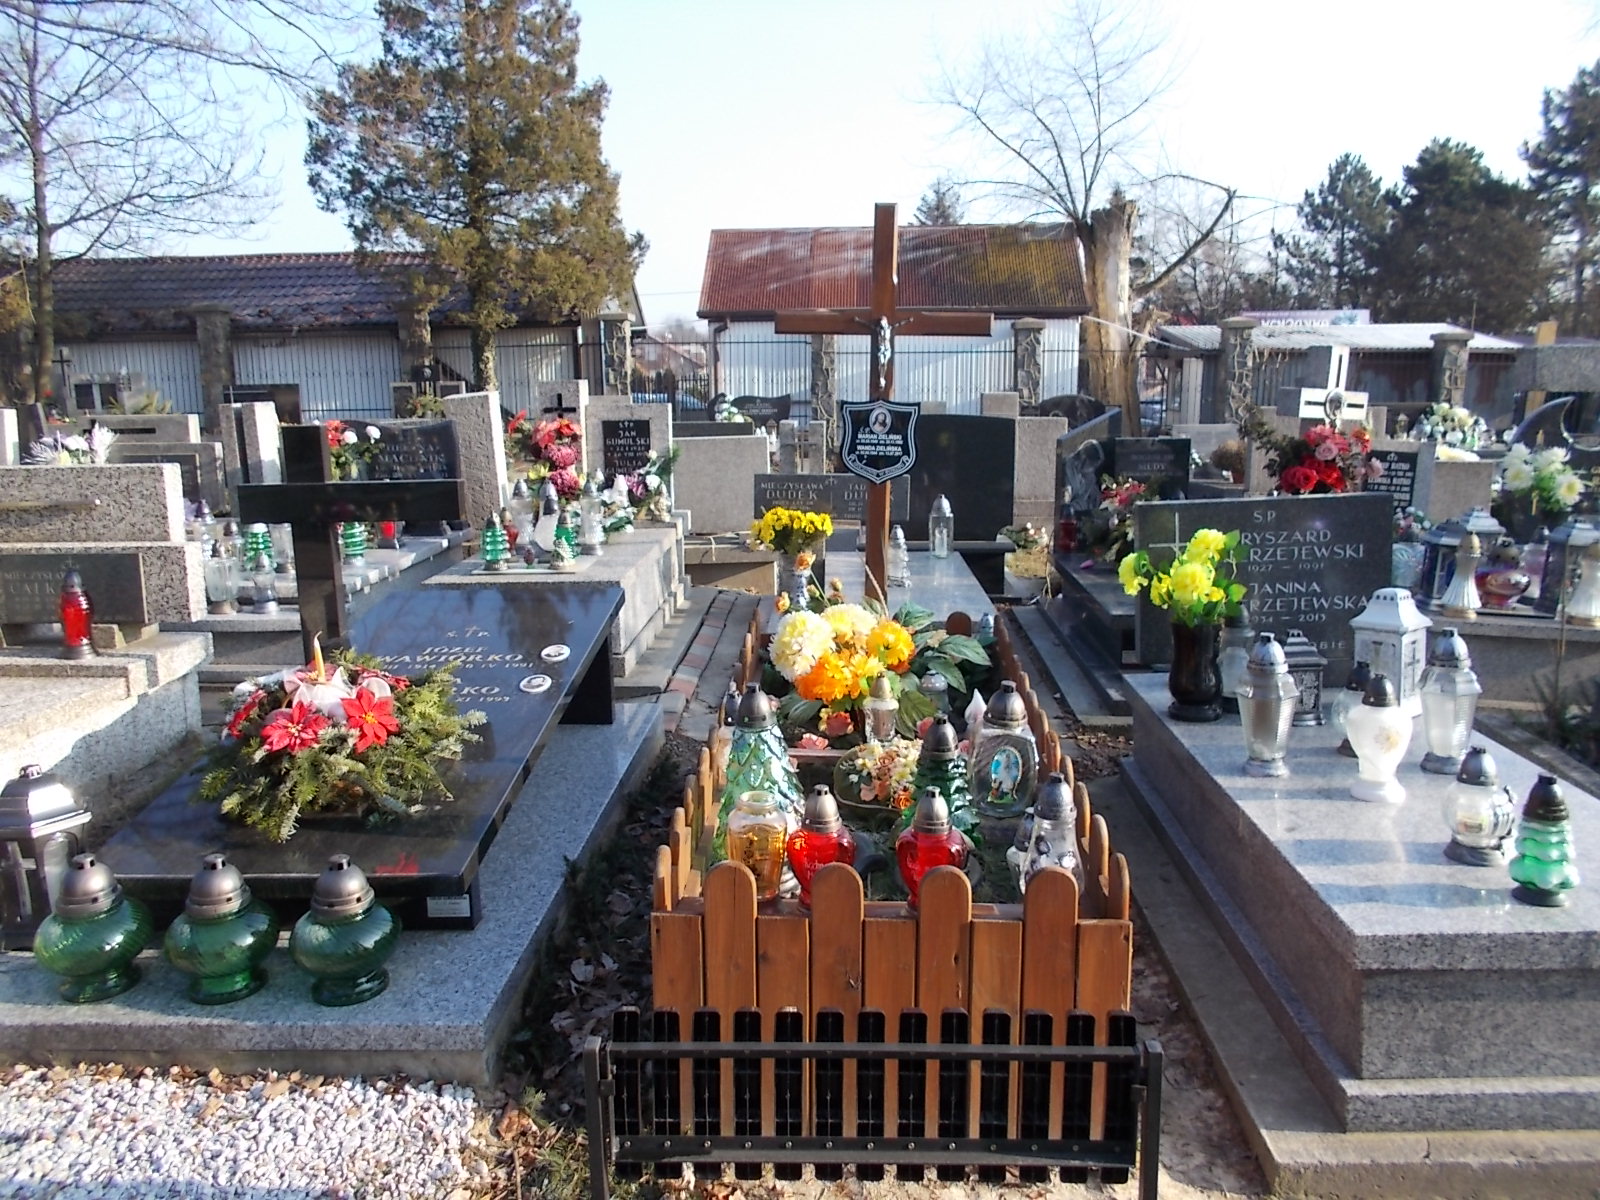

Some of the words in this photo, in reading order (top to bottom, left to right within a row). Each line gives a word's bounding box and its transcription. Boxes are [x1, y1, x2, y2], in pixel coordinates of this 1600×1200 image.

[618, 430, 637, 438] JAN
[606, 437, 650, 446] GUMULSKI
[766, 490, 818, 500] DUDEK
[1241, 529, 1332, 545] RYSZARD
[1242, 544, 1364, 562] RZEJEWSKI
[1248, 581, 1321, 595] JANINA
[1242, 595, 1369, 613] RZEJEWSKA
